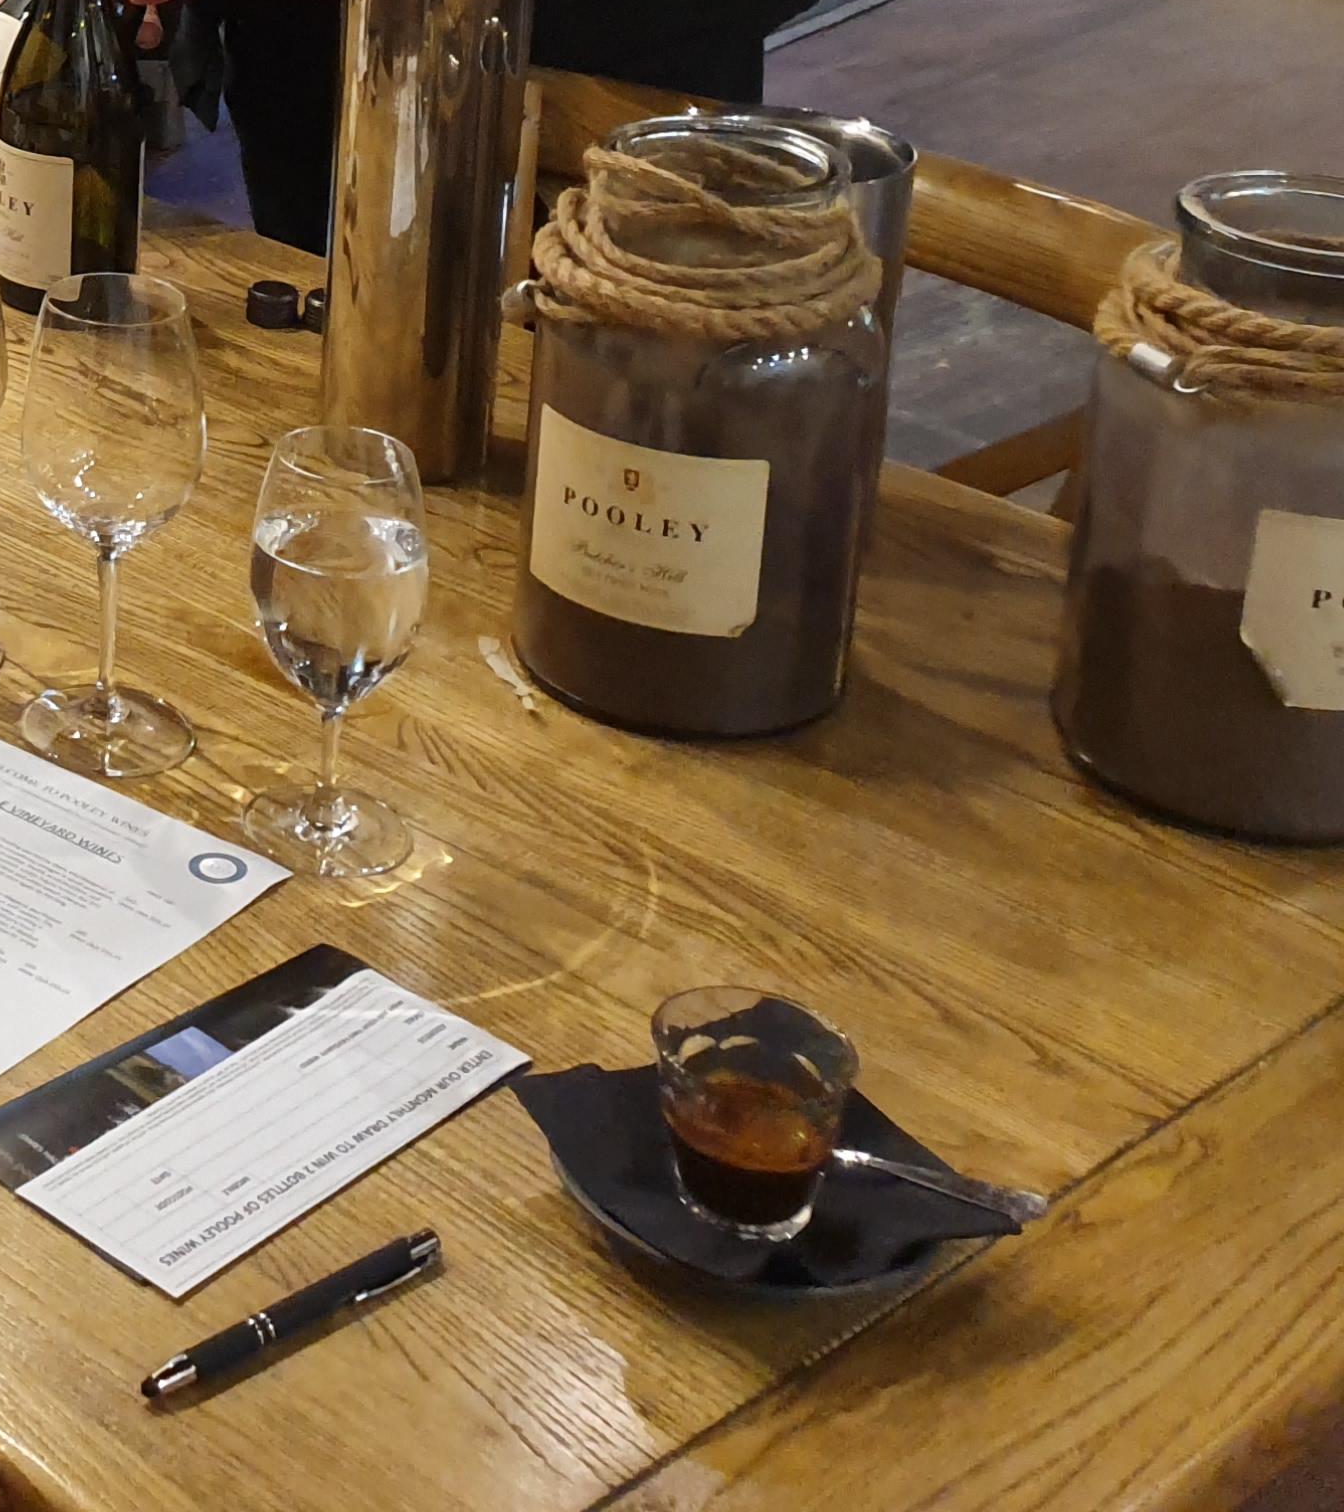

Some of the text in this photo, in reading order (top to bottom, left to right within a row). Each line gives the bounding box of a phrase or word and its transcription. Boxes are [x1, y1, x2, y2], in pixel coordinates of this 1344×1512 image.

[564, 485, 709, 543] POOLEY
[7, 805, 78, 840] VINEYARD
[75, 838, 126, 864] WINES
[156, 1049, 494, 1267] ENTER OUR MONTHLY DRAW TO WIN 2 BOTTLES OF POOLEY WINES
